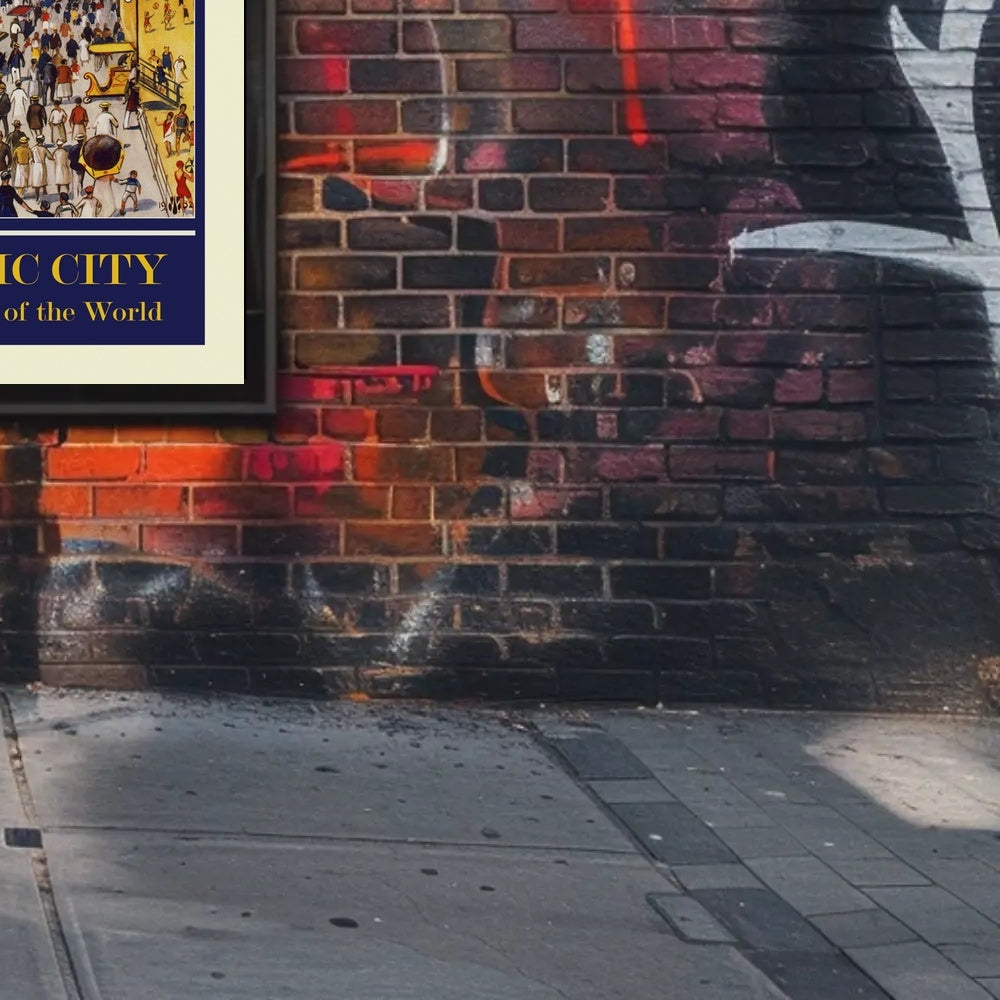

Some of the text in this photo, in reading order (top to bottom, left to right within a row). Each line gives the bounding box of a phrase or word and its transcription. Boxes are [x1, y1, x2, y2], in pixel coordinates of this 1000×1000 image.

[51, 253, 168, 286] CITY
[3, 301, 30, 322] of
[36, 302, 75, 322] the
[83, 301, 163, 322] World
